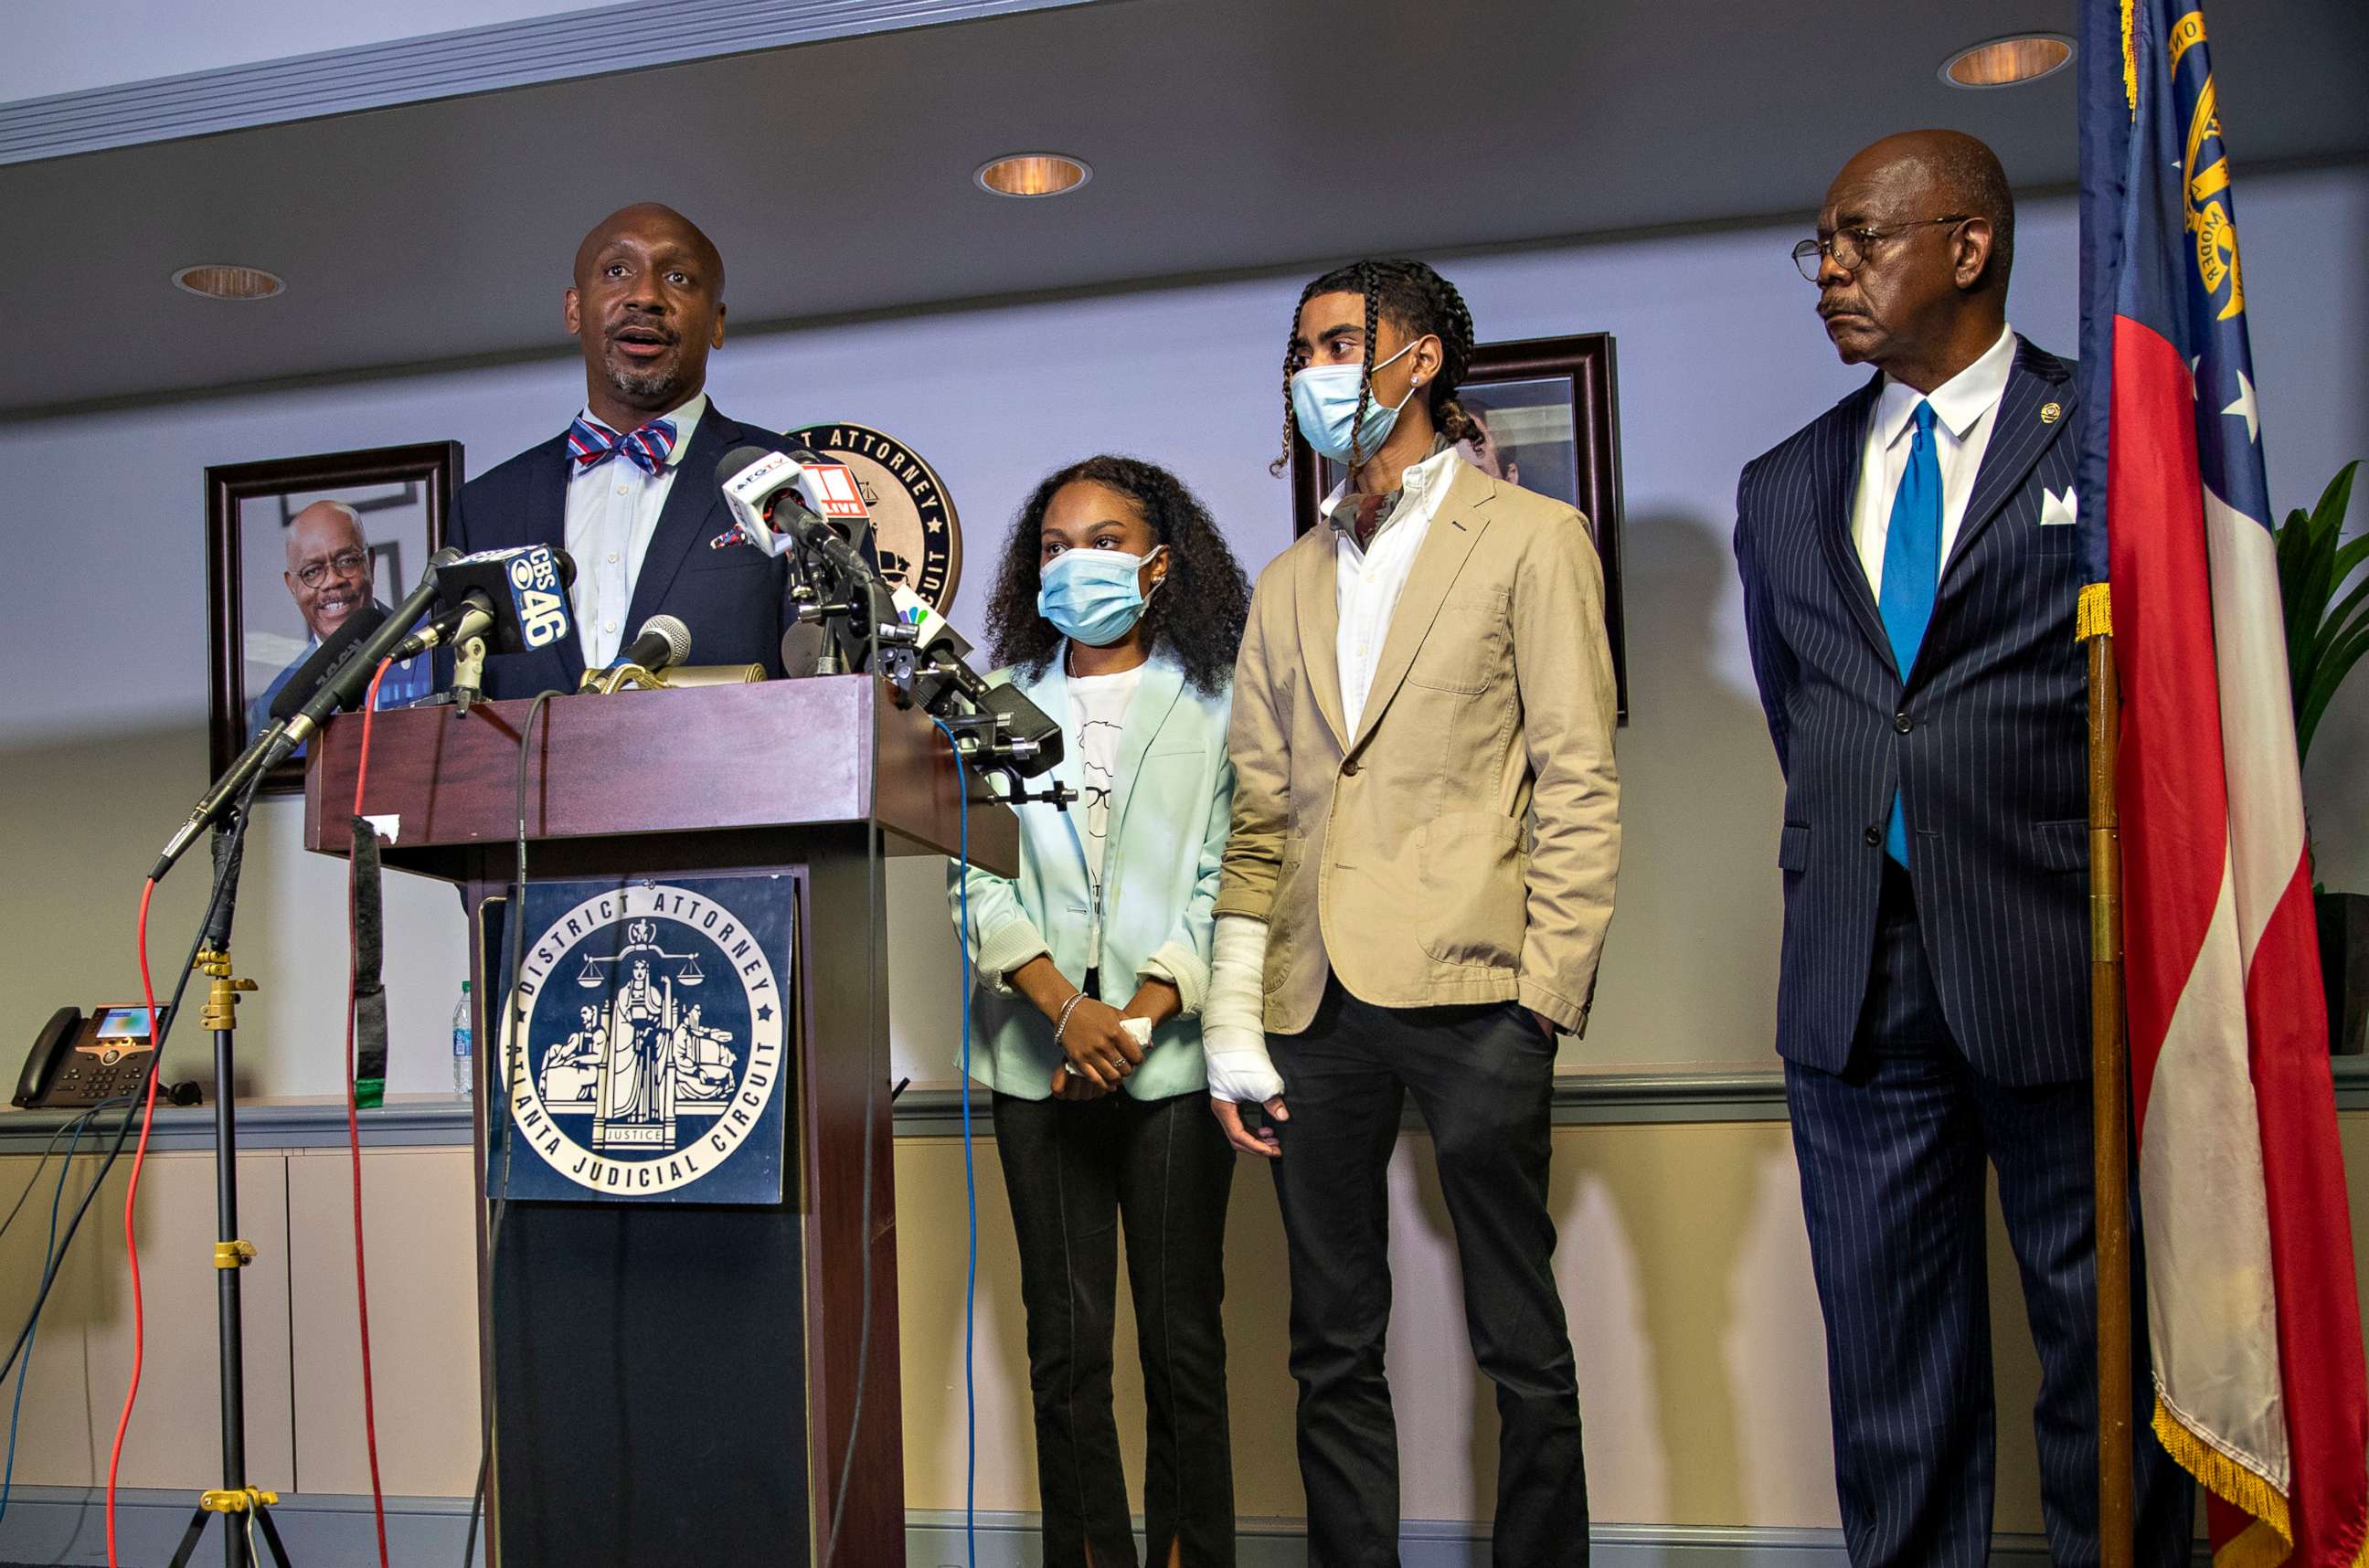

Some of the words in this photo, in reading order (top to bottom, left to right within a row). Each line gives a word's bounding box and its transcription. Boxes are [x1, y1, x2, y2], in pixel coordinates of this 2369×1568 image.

[830, 429, 938, 509] ATTORNEY
[530, 548, 556, 591] CBS
[521, 589, 567, 647] 46
[518, 895, 629, 996] DISTRICT
[653, 893, 770, 991] ATTORNEY
[572, 1155, 698, 1188] JUDICIAL
[711, 1042, 775, 1153] CIRCUIT
[607, 1130, 662, 1140] JUSTICE
